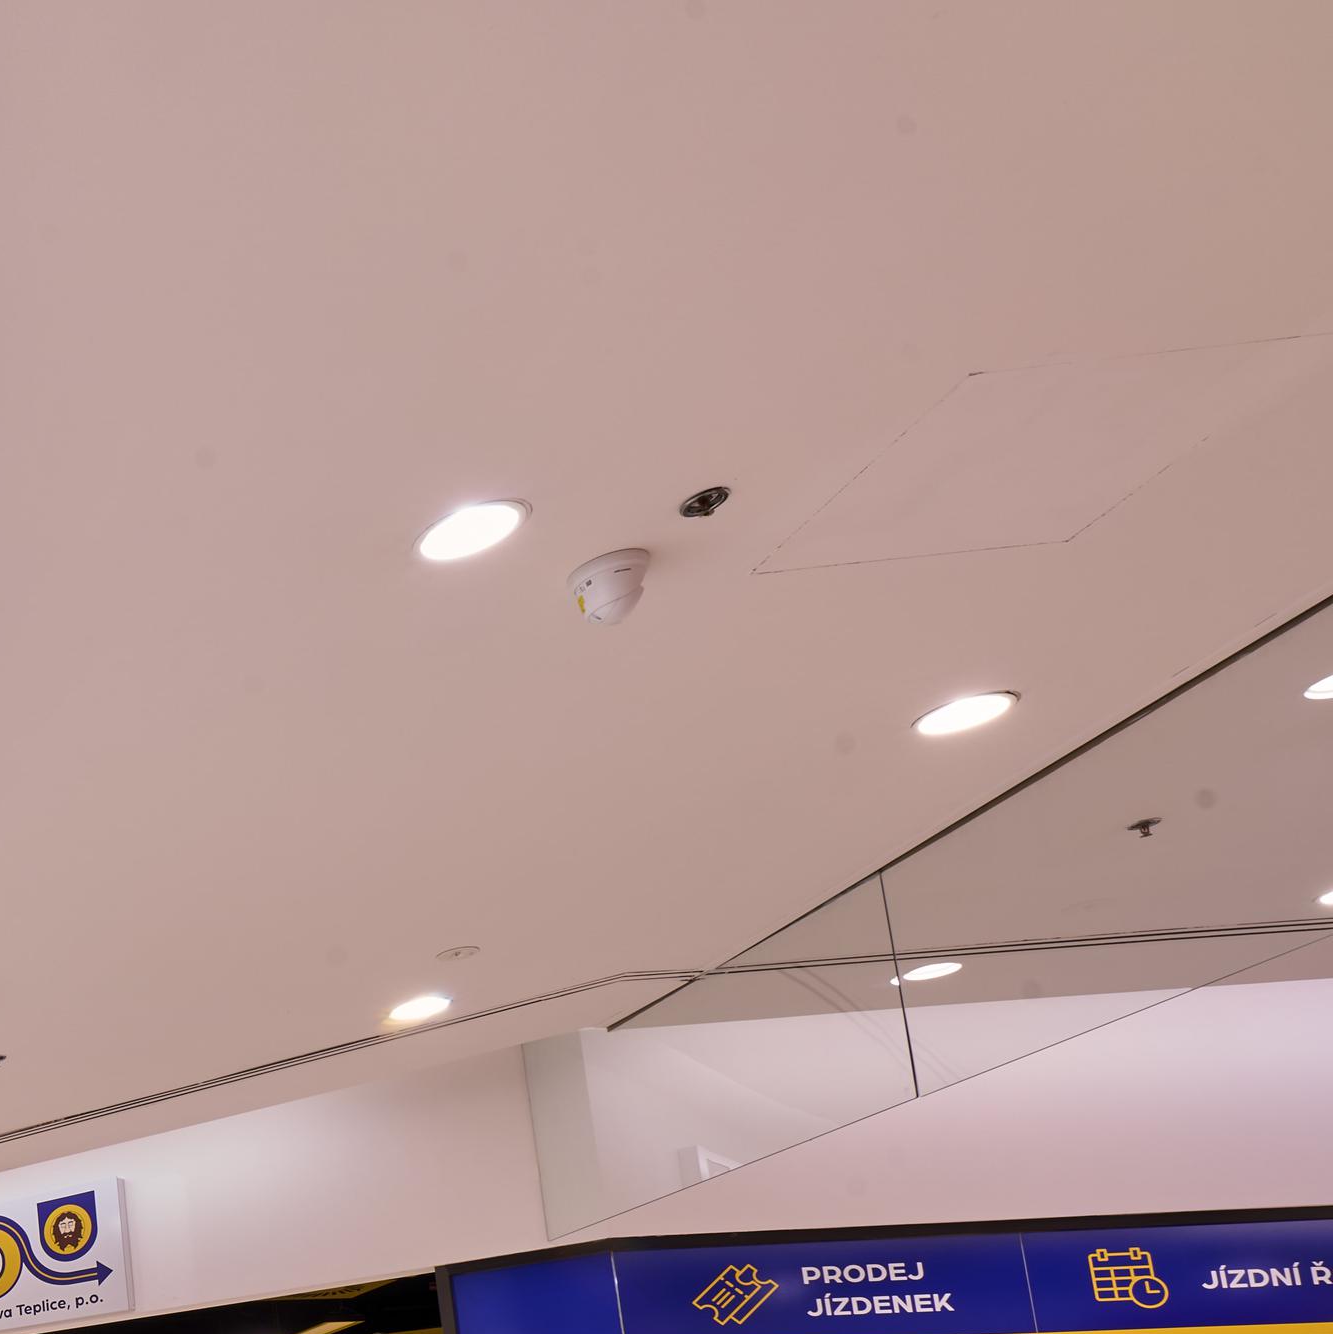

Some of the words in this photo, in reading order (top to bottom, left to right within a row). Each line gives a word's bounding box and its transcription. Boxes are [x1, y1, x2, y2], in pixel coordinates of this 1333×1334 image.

[801, 1261, 925, 1285] PRODEJ
[1201, 1261, 1302, 1290] JÍZDNÍ
[16, 1298, 71, 1317] Teplice,
[75, 1293, 104, 1307] p.o.
[806, 1292, 955, 1317] JÍZDENEK
